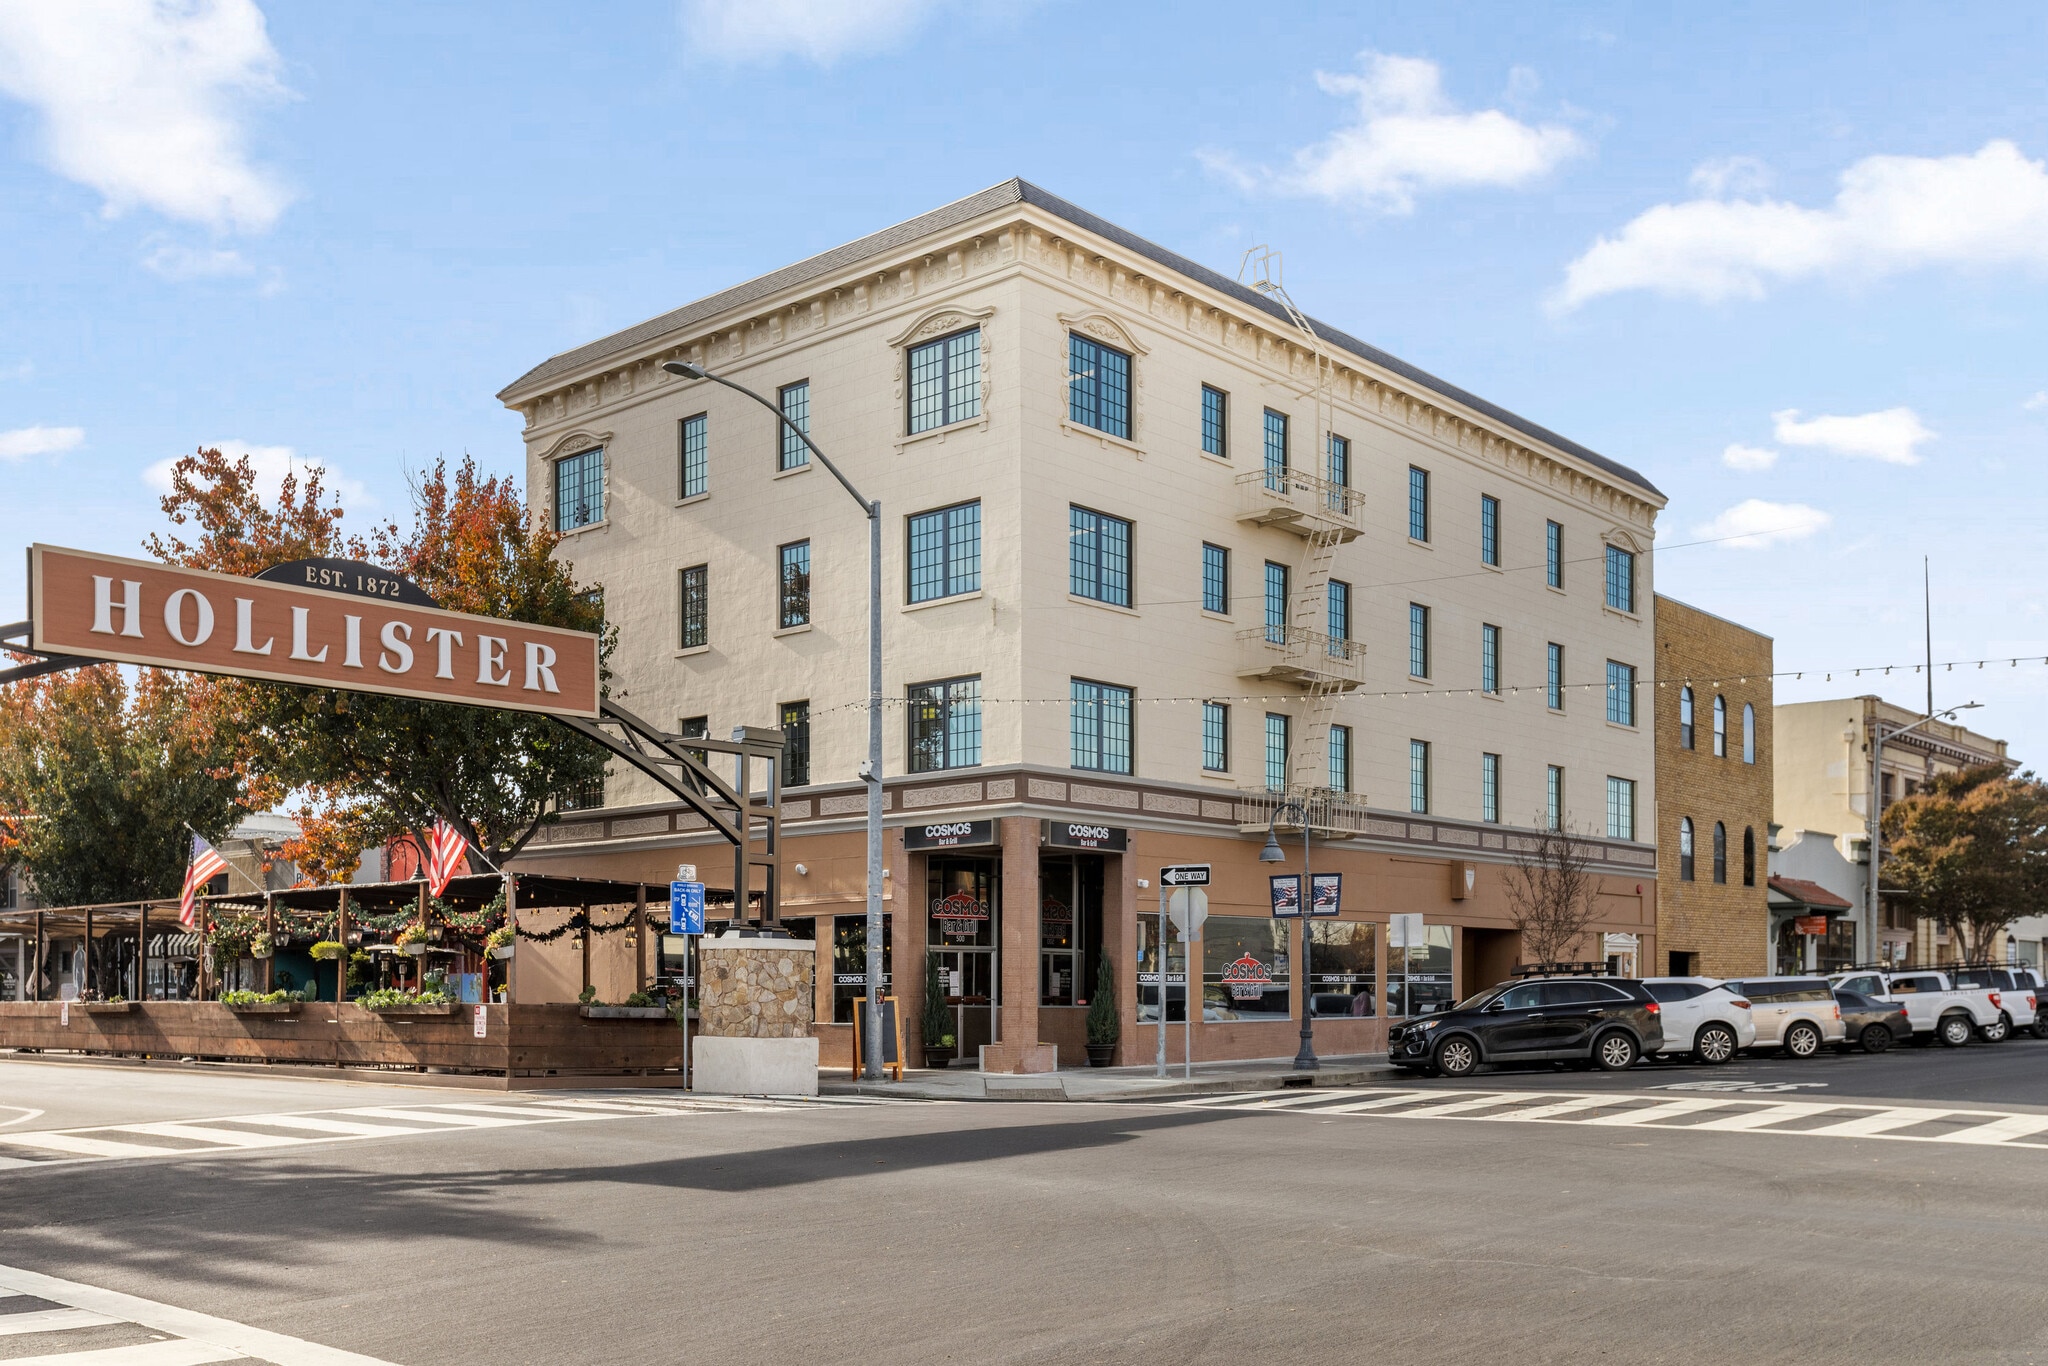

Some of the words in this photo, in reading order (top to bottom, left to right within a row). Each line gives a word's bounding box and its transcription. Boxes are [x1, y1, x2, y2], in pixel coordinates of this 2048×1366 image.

[306, 565, 347, 588] EST.
[357, 575, 400, 597] 1872
[90, 574, 560, 694] HOLLISTER
[925, 822, 972, 838] COSMOS
[1068, 824, 1109, 839] COSMOS
[938, 838, 946, 846] Bar
[950, 837, 958, 845] Grill
[1174, 872, 1189, 880] ONE
[1190, 872, 1205, 880] WAY
[932, 898, 990, 917] COSMOS
[943, 919, 955, 933] Bar
[963, 919, 979, 934] Grill
[1140, 974, 1160, 982] COSMO
[1222, 962, 1272, 980] COSMOS
[839, 975, 863, 983] COSMOS
[1231, 982, 1244, 997] Bar
[1250, 982, 1263, 997] Grill
